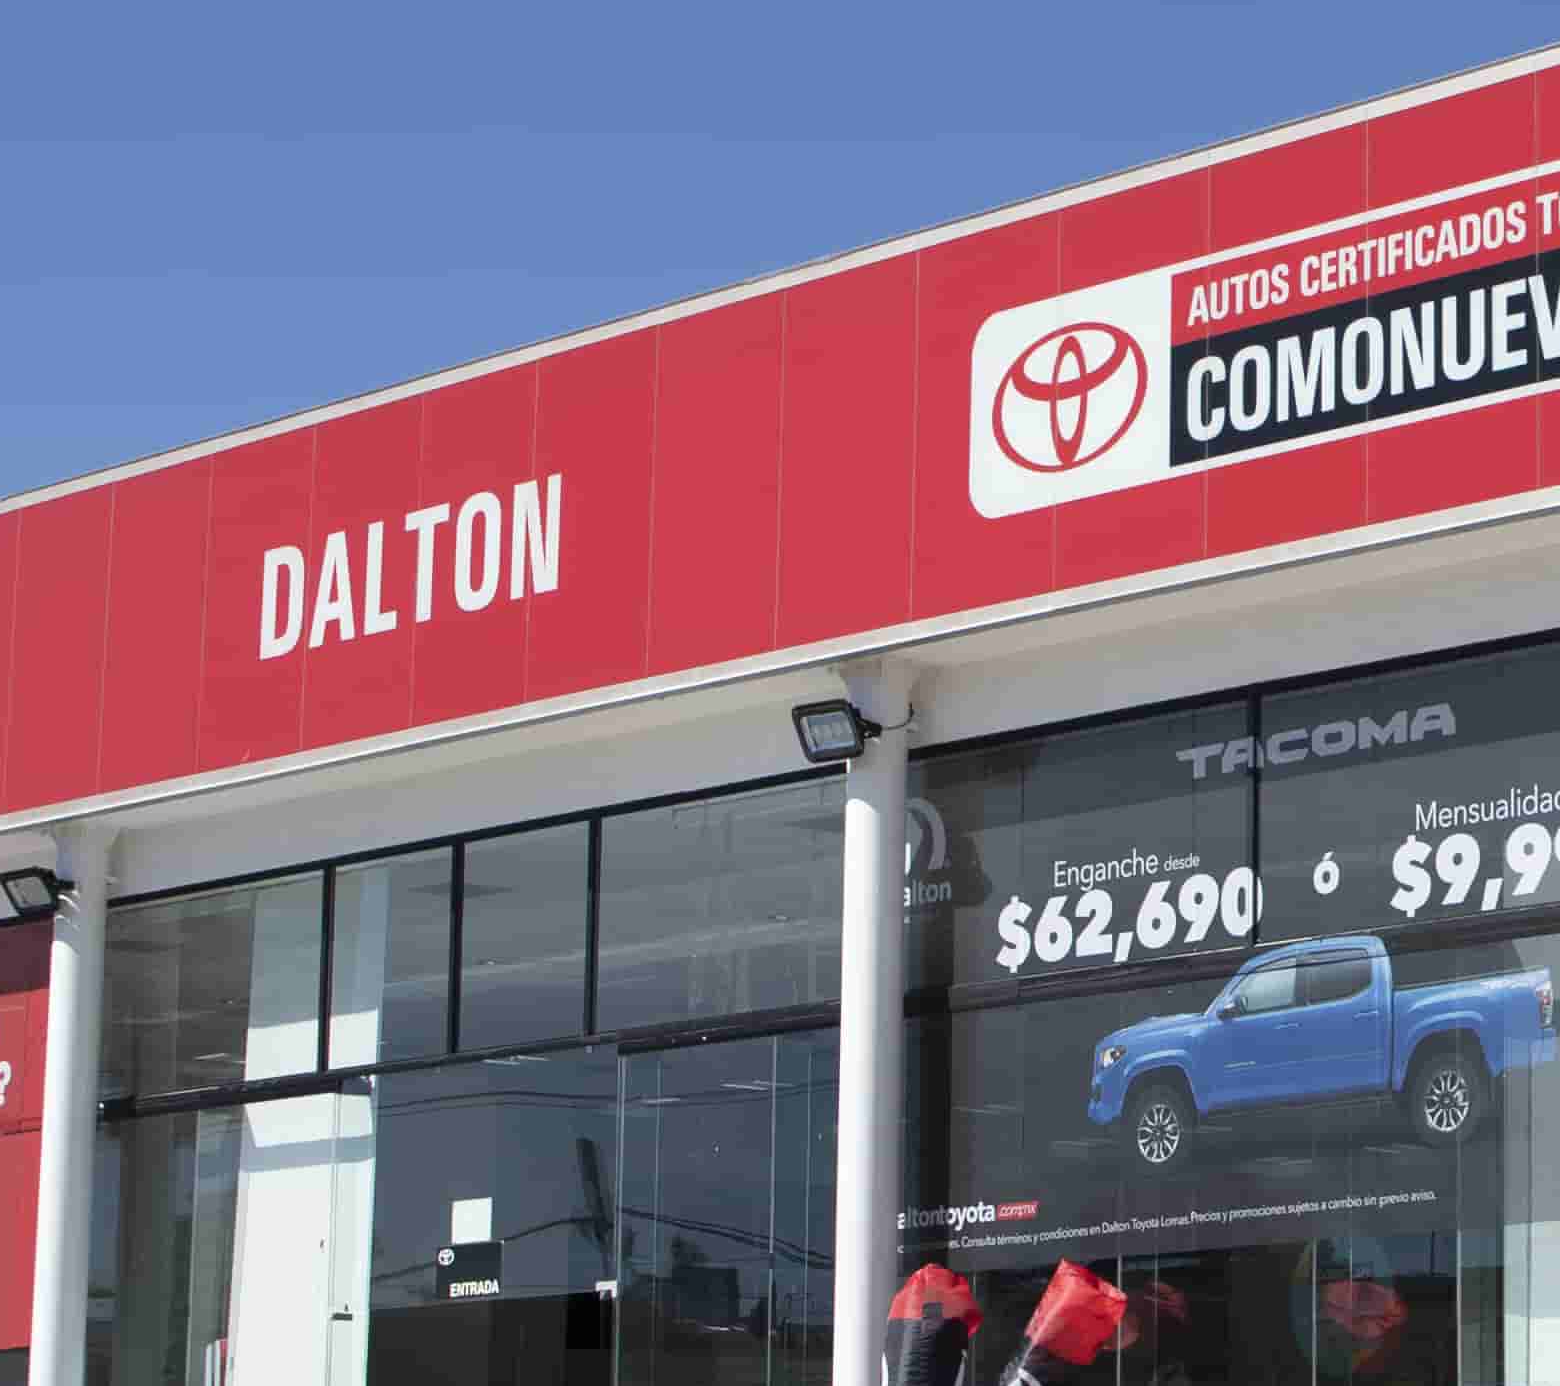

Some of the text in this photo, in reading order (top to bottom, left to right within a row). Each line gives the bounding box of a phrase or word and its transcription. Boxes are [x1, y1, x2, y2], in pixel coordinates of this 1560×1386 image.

[1186, 262, 1290, 327] AUTOS
[1299, 200, 1527, 298] CERTIFICADOS
[260, 473, 563, 660] DALTON
[1176, 702, 1457, 780] TACOMA
[1053, 848, 1201, 892] Enganche desde
[995, 865, 1264, 974] $62,690
[449, 1279, 500, 1299] ENTRADA
